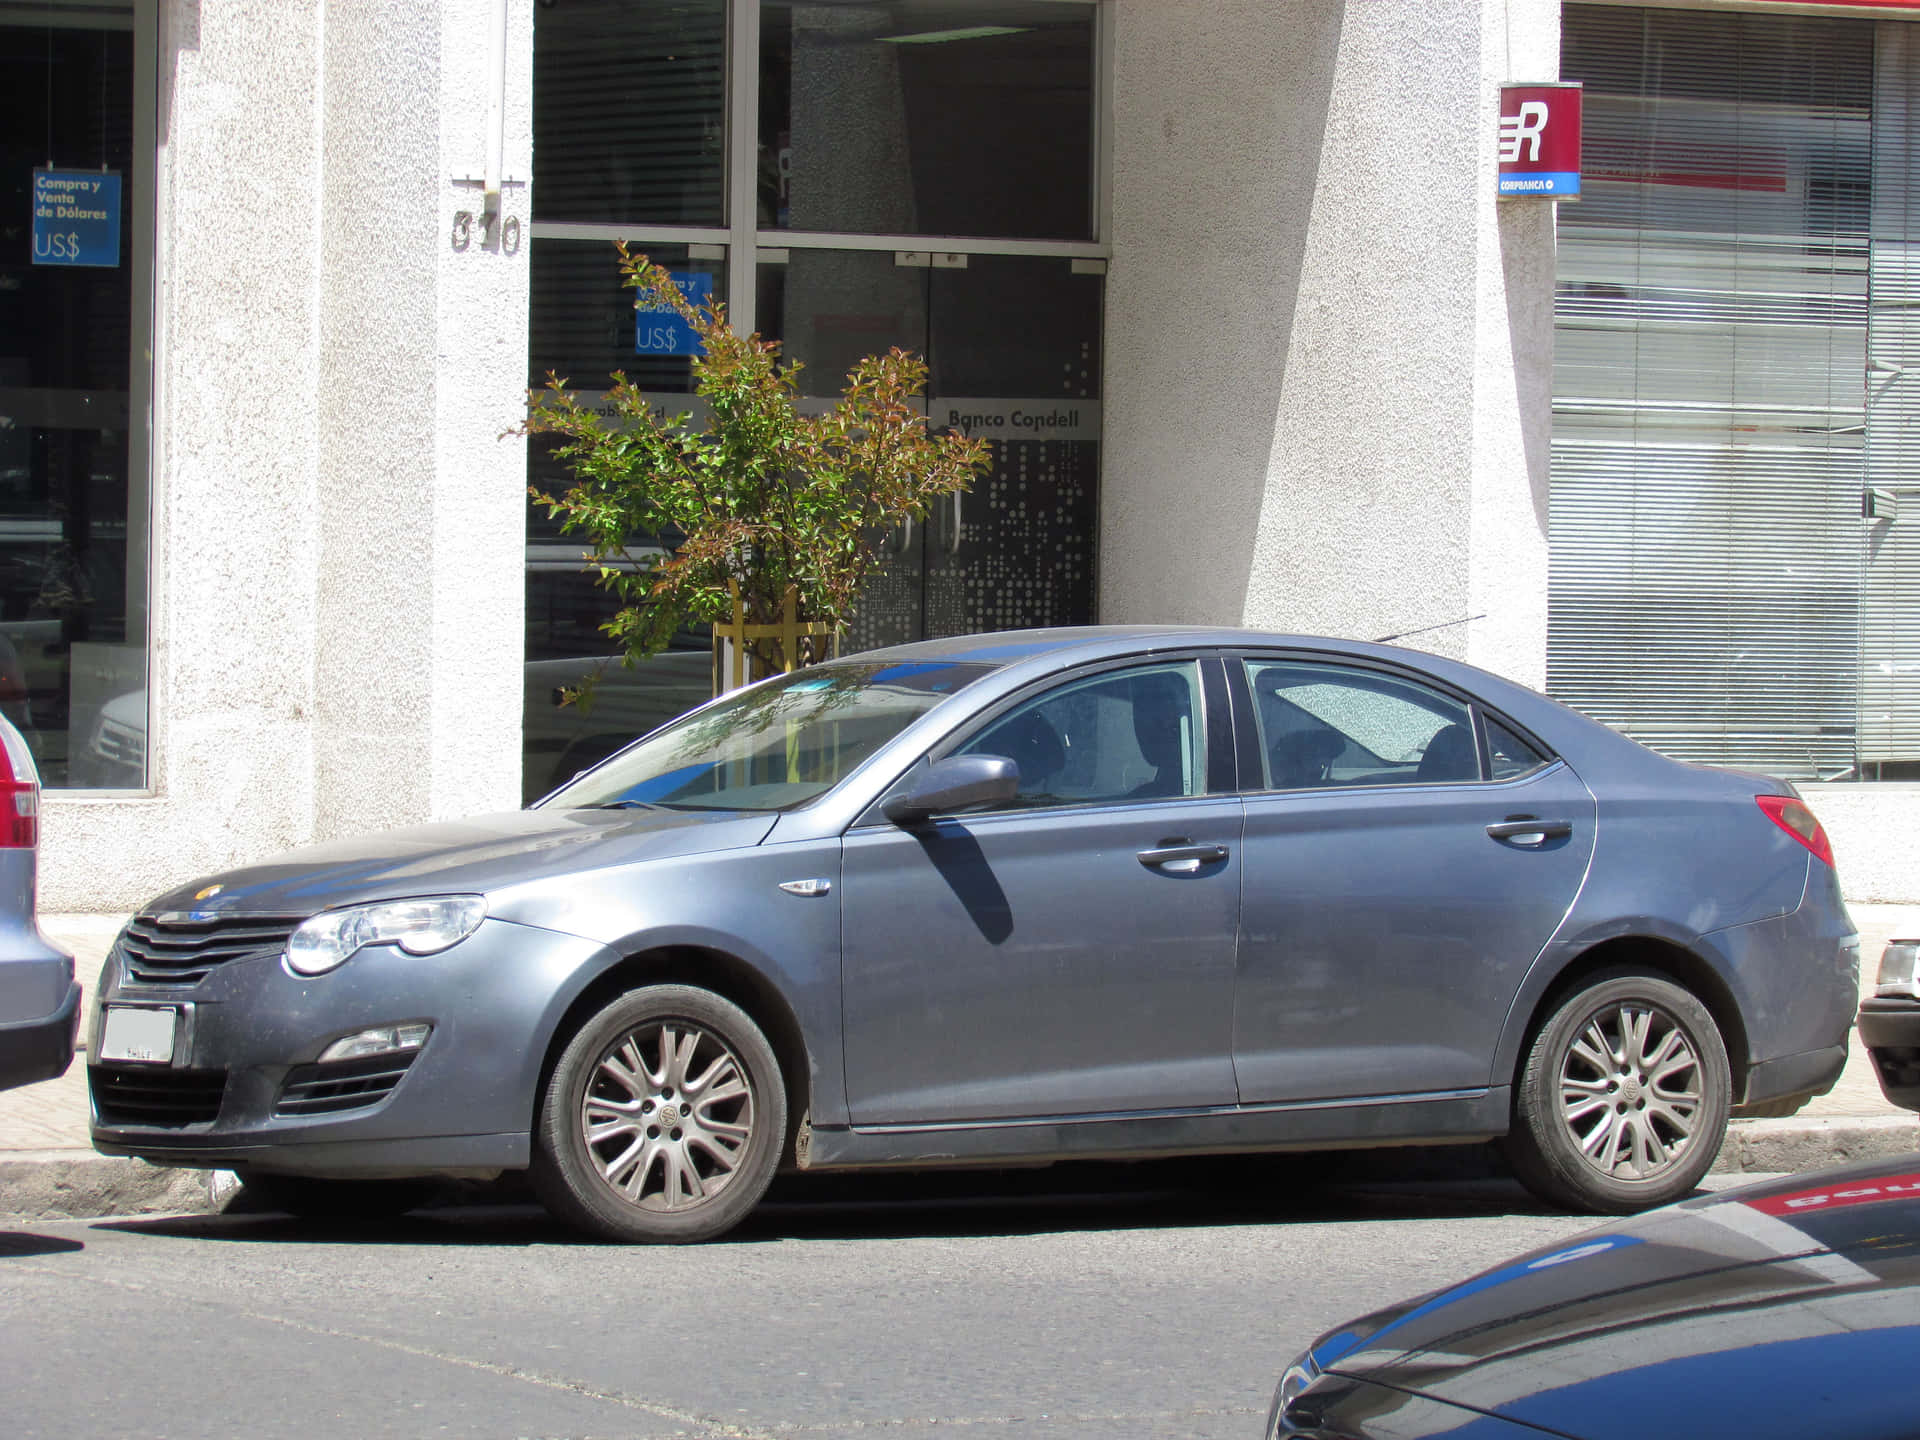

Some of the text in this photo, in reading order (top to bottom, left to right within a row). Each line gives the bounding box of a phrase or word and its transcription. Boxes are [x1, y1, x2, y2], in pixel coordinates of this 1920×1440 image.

[37, 176, 101, 193] Compra y
[37, 191, 75, 204] Venta
[36, 205, 107, 219] de Dólares
[35, 232, 80, 261] US$
[637, 325, 677, 352] US$
[949, 410, 1078, 427] Banco Condell
